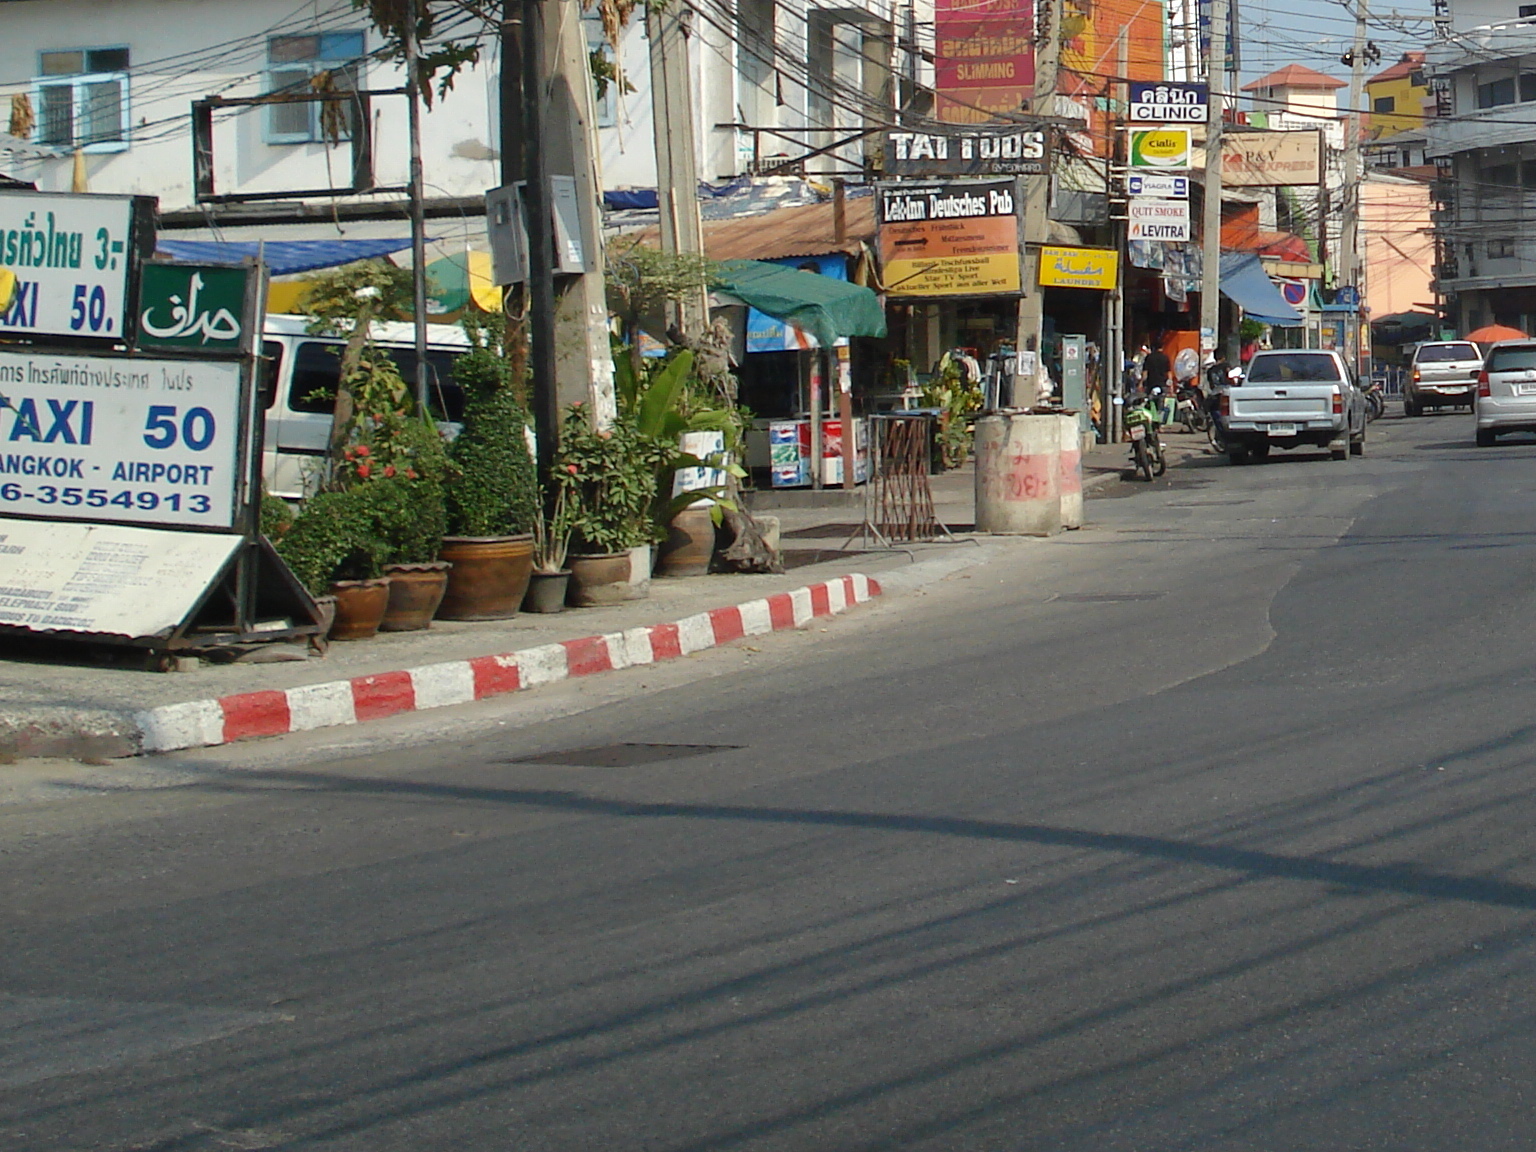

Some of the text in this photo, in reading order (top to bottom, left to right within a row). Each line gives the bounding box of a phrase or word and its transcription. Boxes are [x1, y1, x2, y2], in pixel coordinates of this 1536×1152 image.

[1141, 85, 1199, 104] คลินิก
[1137, 106, 1202, 119] CLINIC
[1149, 139, 1177, 148] Cialis
[929, 191, 986, 218] Deutsches
[989, 189, 1013, 214] Pub
[1132, 207, 1185, 219] QUIT SMOKE
[1142, 225, 1184, 237] LEVITRA
[70, 284, 113, 332] 50.
[141, 271, 241, 345] صراف
[143, 405, 216, 451] 50
[0, 453, 84, 479] NGKOK
[112, 460, 214, 486] AIRPORT
[0, 482, 212, 513] 6-3554913
